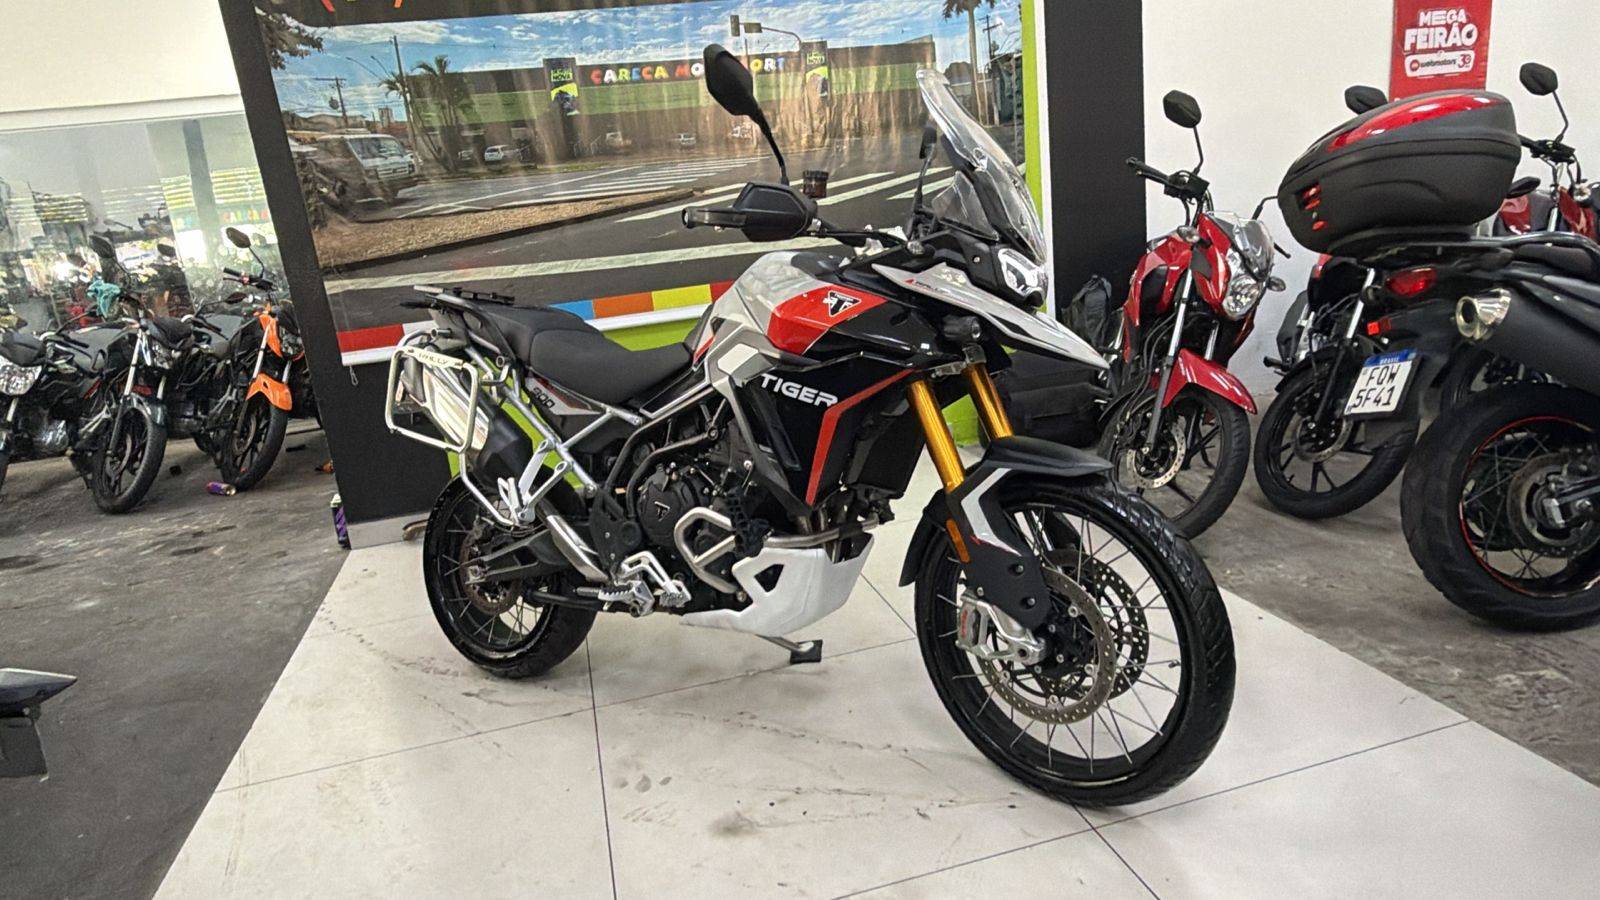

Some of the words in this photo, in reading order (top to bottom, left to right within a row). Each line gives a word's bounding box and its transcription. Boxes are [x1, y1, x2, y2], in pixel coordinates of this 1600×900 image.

[1419, 8, 1467, 26] MEGA
[1404, 23, 1478, 51] FEIRÃO
[591, 65, 669, 85] CARECA
[761, 373, 838, 407] TIGER
